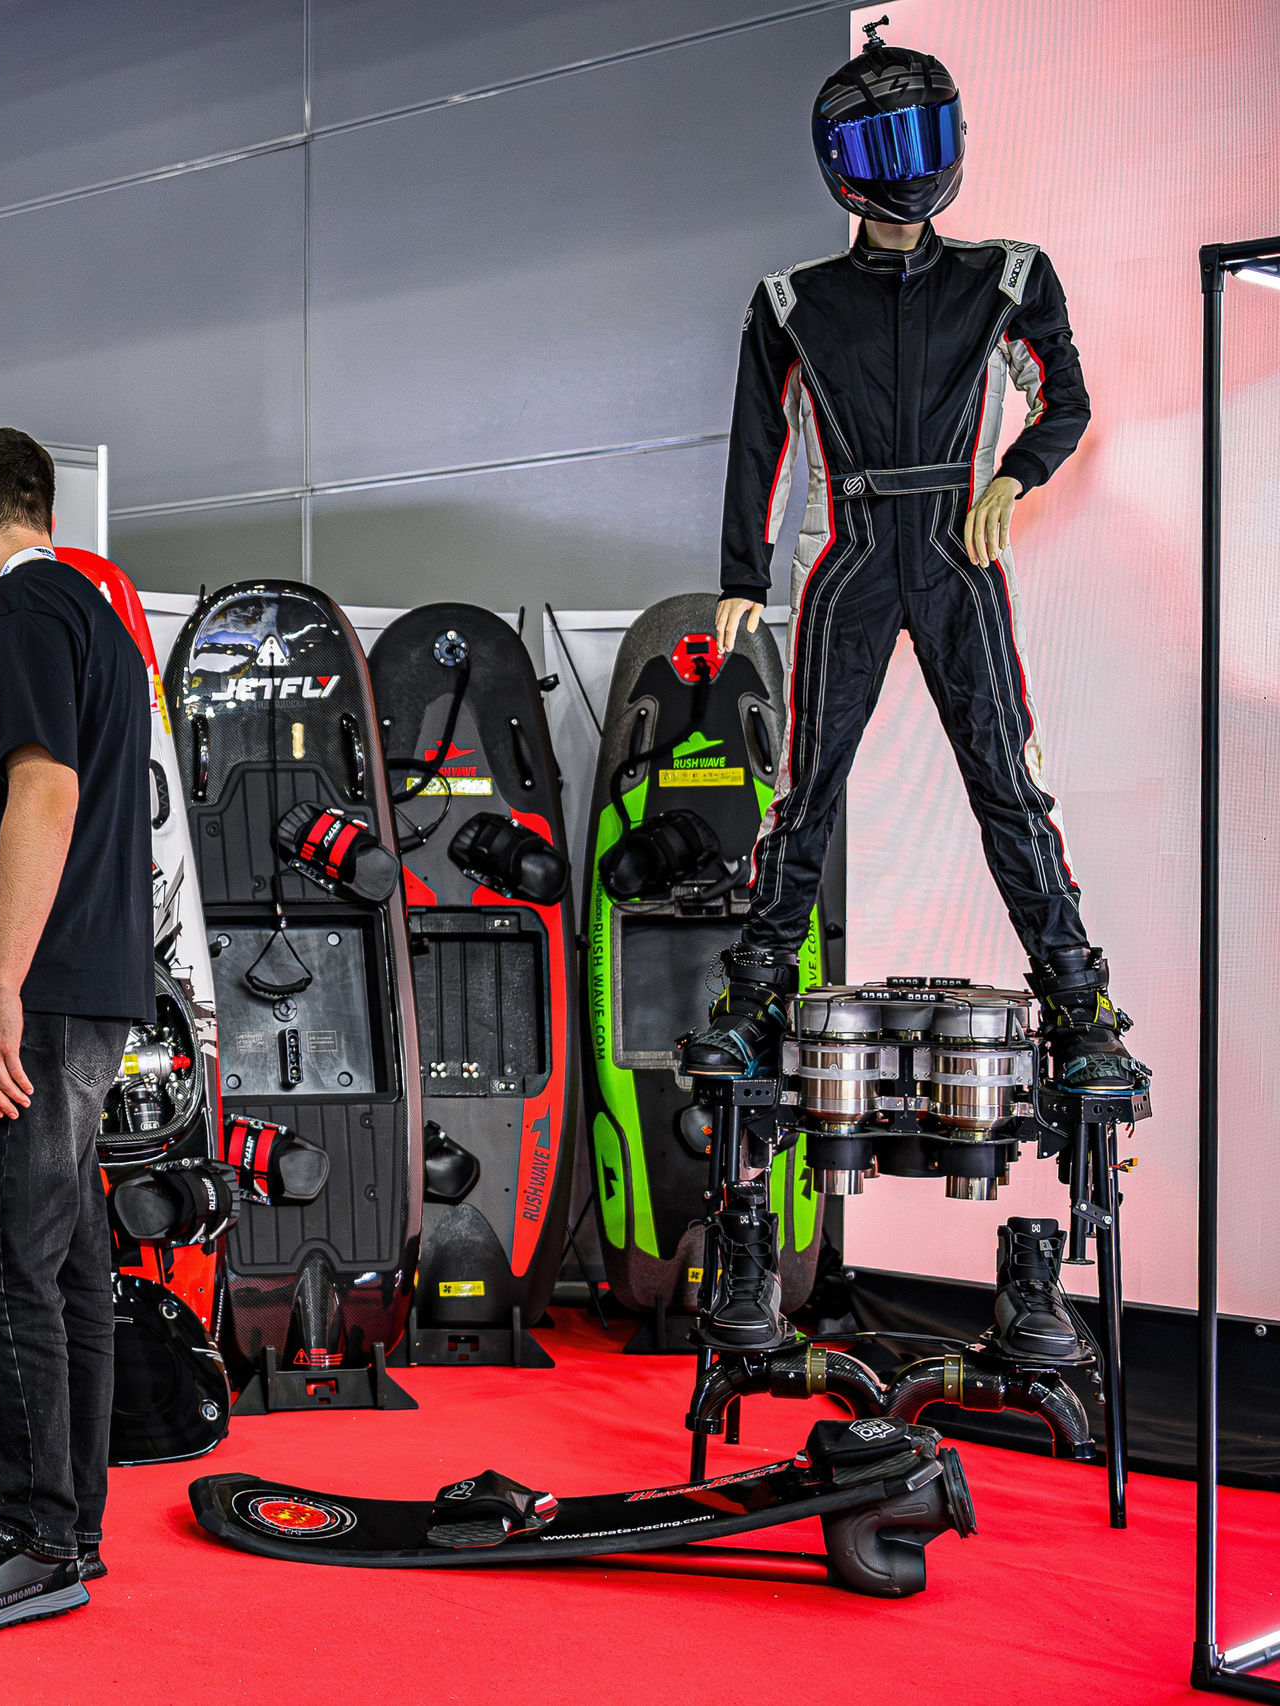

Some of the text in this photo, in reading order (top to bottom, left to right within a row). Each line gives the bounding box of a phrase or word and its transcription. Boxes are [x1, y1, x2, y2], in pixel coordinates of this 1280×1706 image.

[211, 675, 341, 701] JETFLY
[451, 766, 477, 777] WAVE
[673, 756, 727, 769] RUSH WAVE
[592, 923, 606, 1060] RUSH WAVE.COM
[201, 1177, 217, 1211] DLESURF
[523, 1150, 550, 1222] RUSH WAVE
[542, 1514, 713, 1541] www.zapata-racing.com
